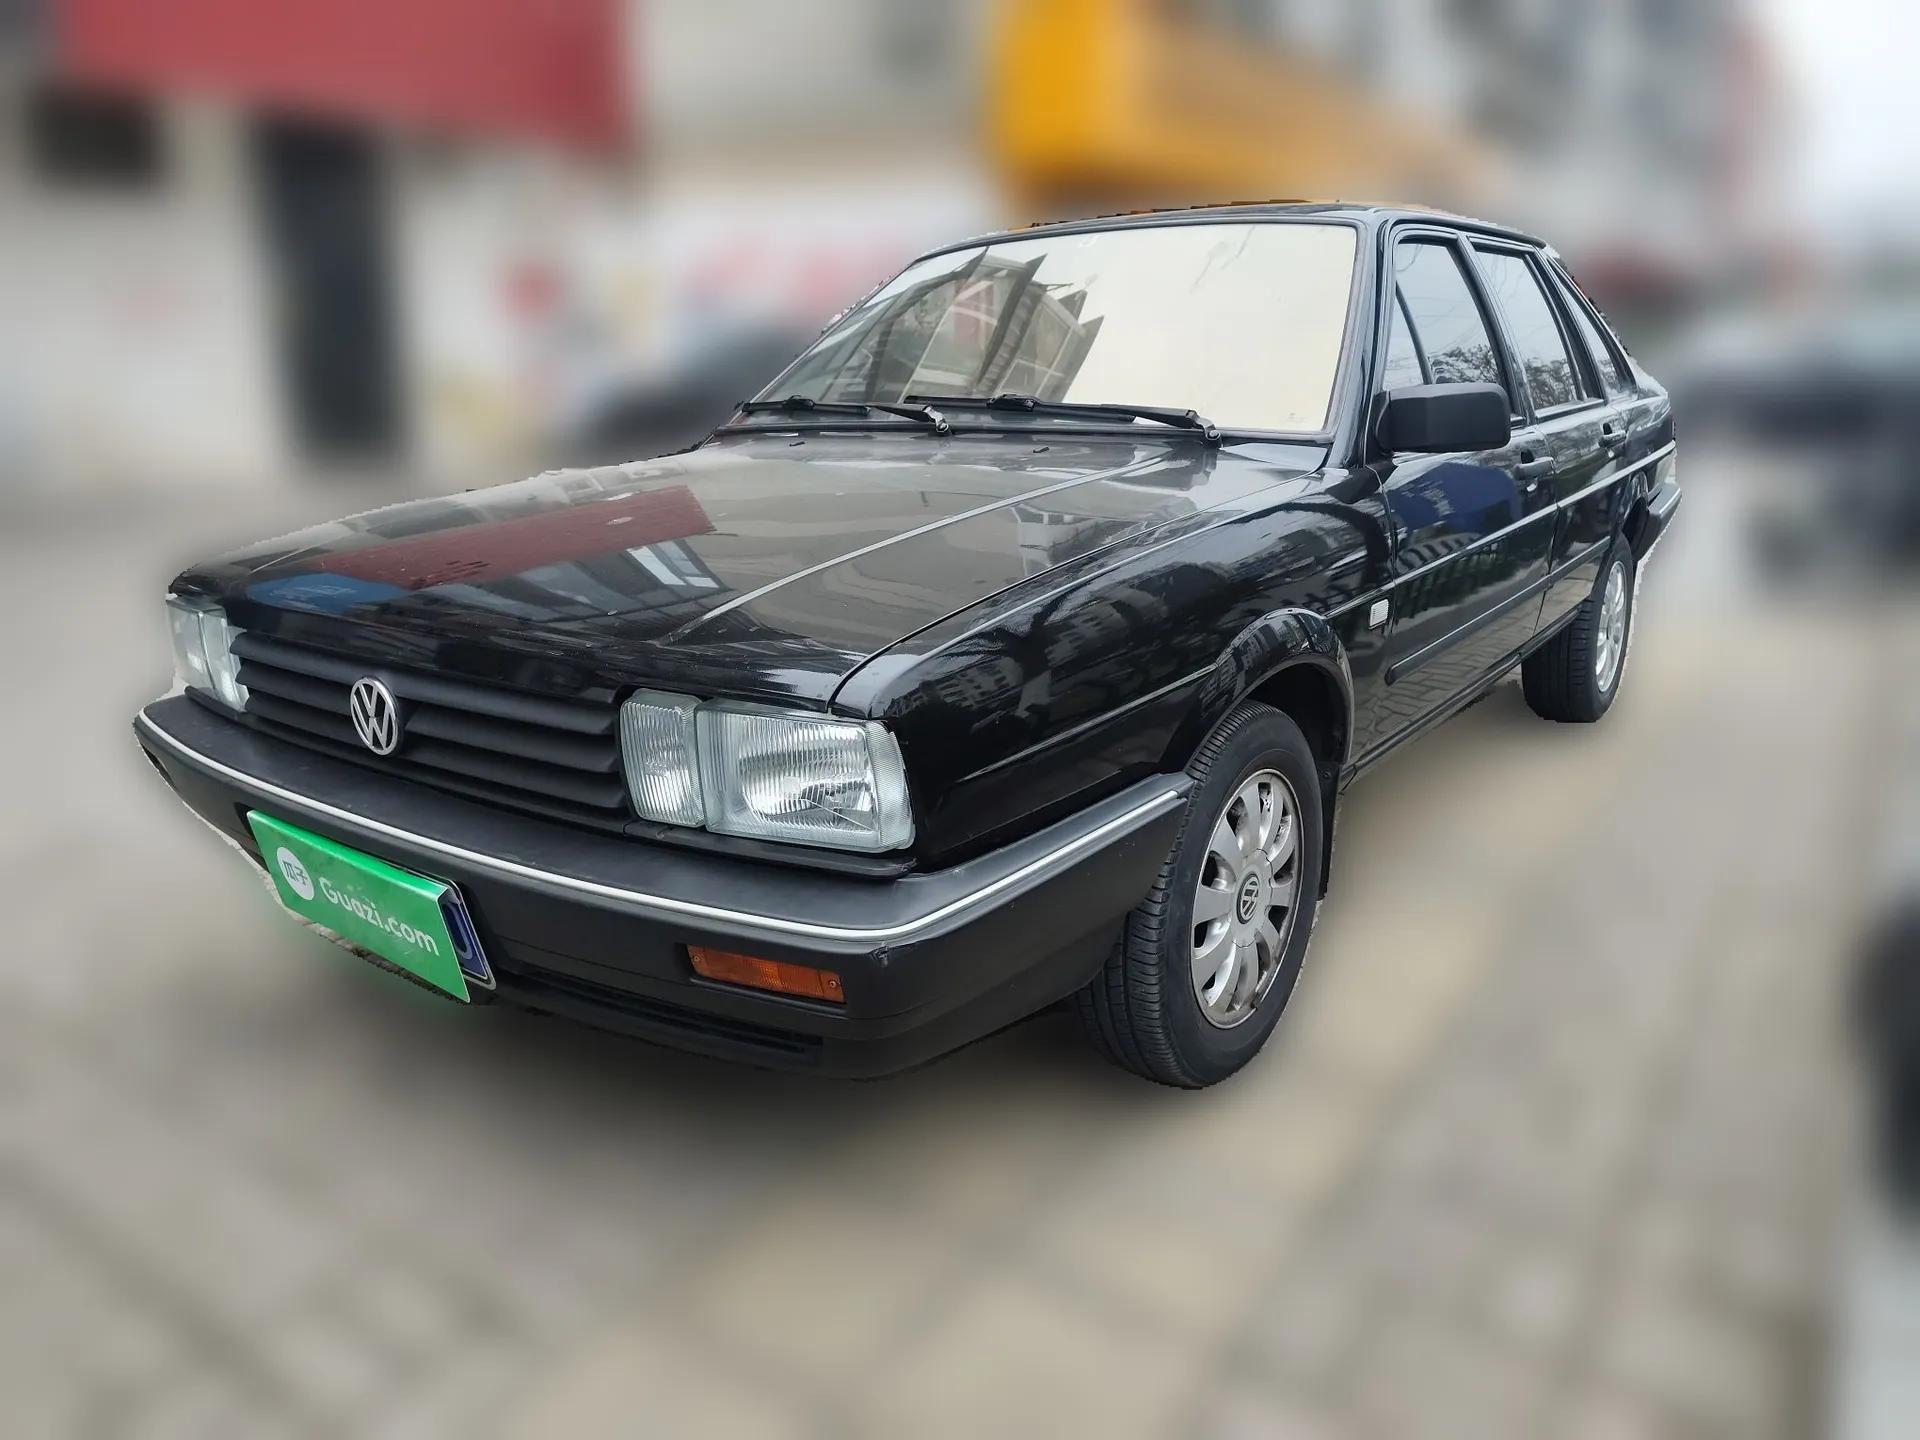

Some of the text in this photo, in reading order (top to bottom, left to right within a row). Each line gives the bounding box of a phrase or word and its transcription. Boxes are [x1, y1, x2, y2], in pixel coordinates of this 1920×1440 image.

[351, 679, 397, 755] VW
[282, 860, 308, 886] 瓜子
[318, 877, 440, 956] Guazi.com
